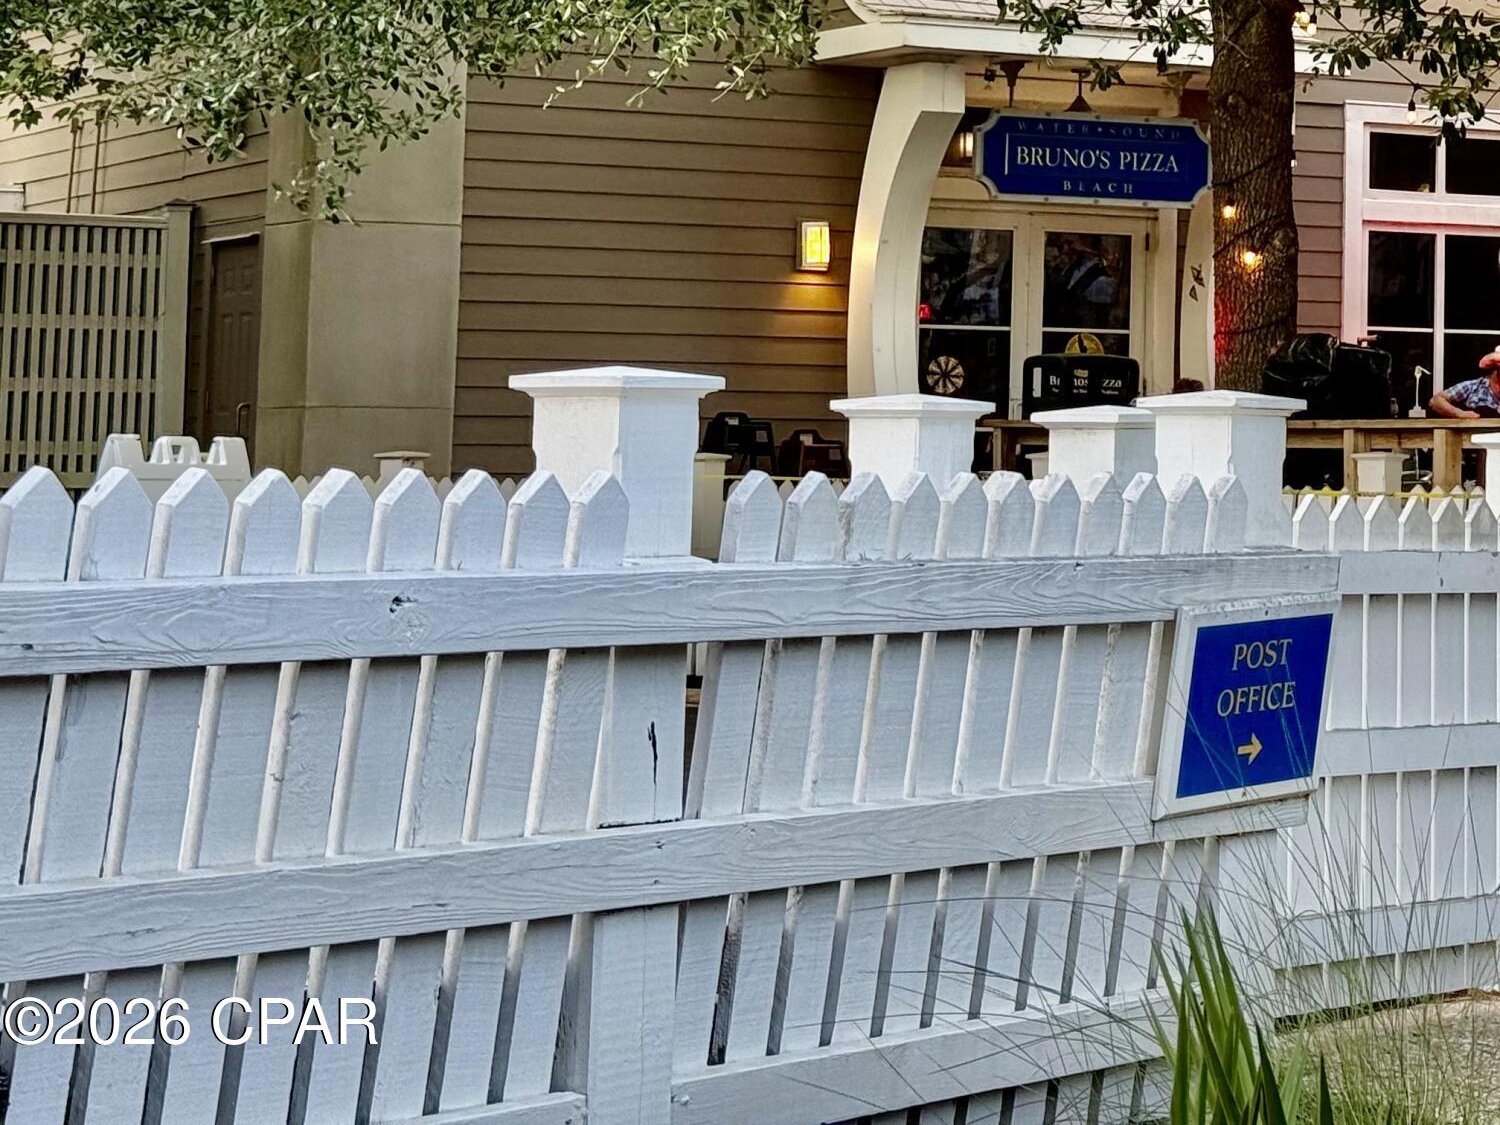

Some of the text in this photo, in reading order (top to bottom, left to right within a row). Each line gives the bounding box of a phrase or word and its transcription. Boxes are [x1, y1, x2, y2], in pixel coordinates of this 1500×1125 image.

[1017, 121, 1181, 140] WATER SOUND
[1016, 145, 1180, 173] BRUNO'S PIZZA
[1063, 180, 1134, 194] BEACH
[1231, 638, 1293, 671] POST
[1216, 681, 1297, 717] OFFICE
